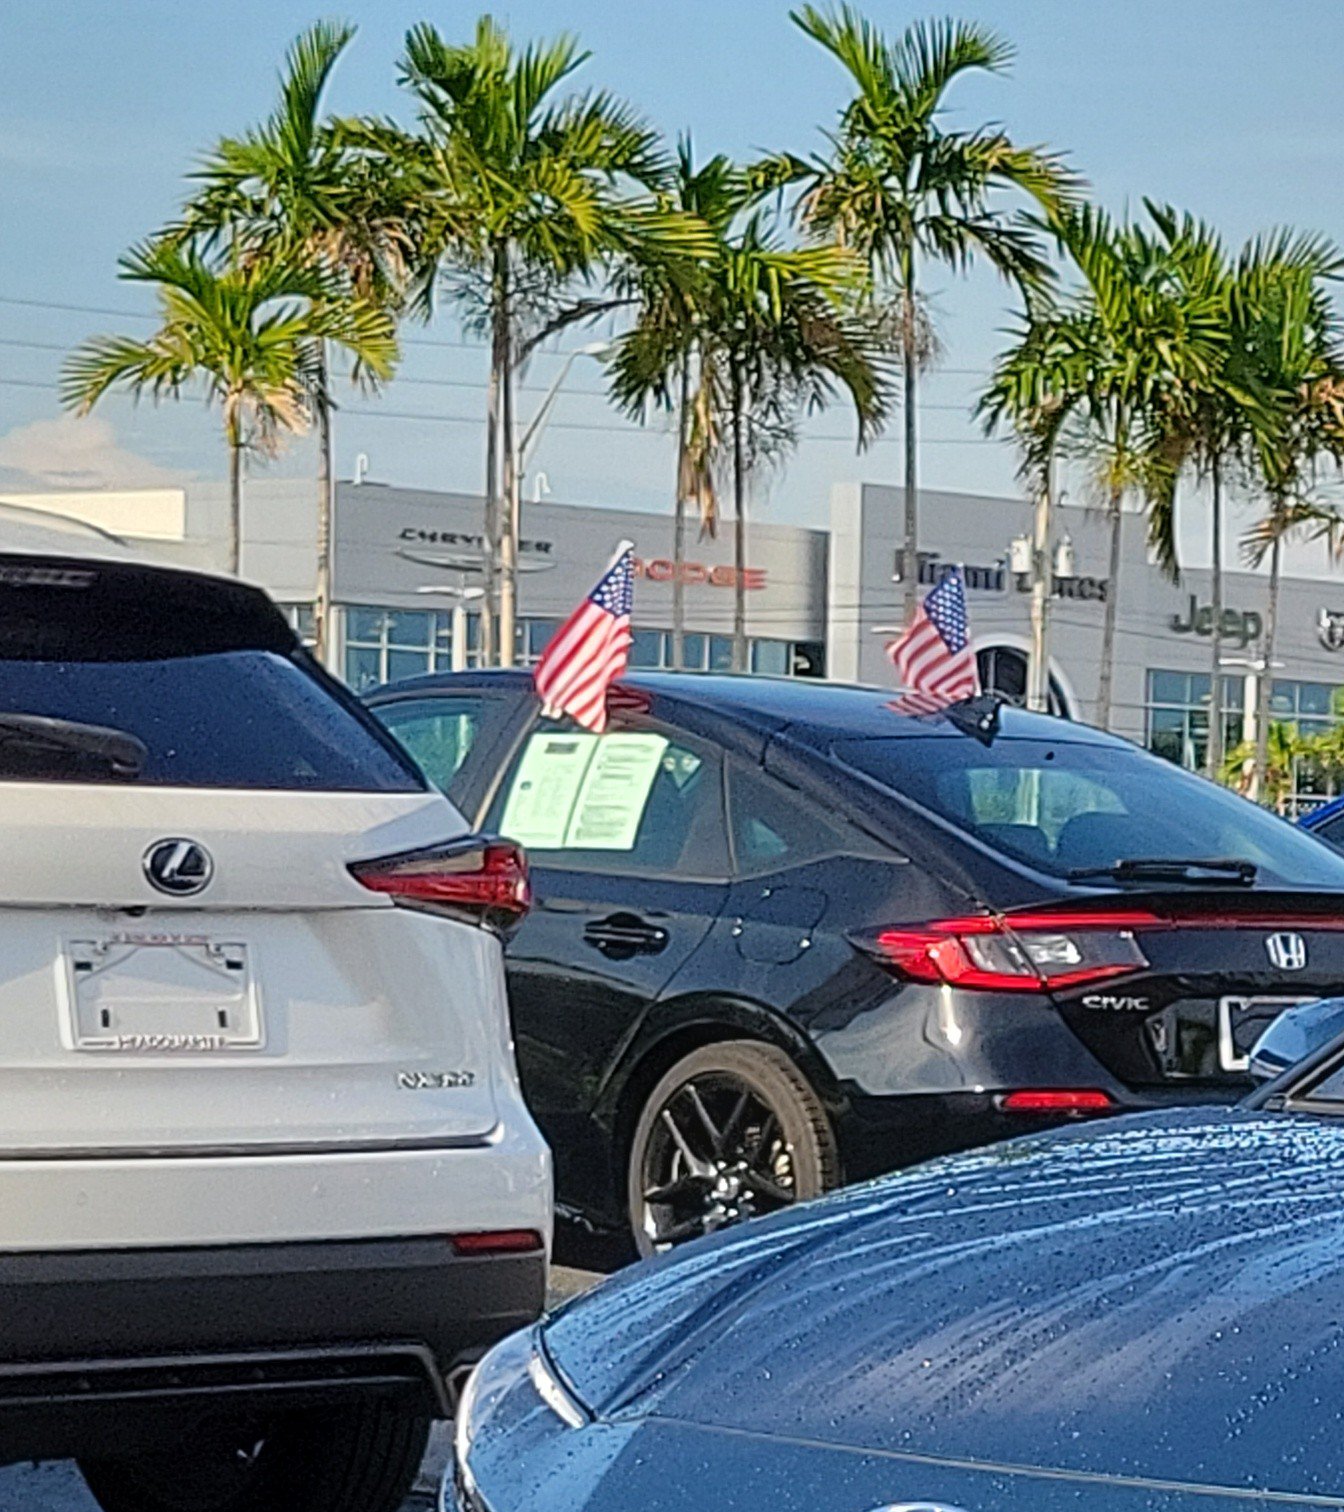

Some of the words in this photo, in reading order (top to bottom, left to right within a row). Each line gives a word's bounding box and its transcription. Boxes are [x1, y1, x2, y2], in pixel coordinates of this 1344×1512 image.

[400, 527, 553, 555] CHRYER
[1170, 594, 1262, 650] Jeep
[1082, 995, 1149, 1010] CIVIC
